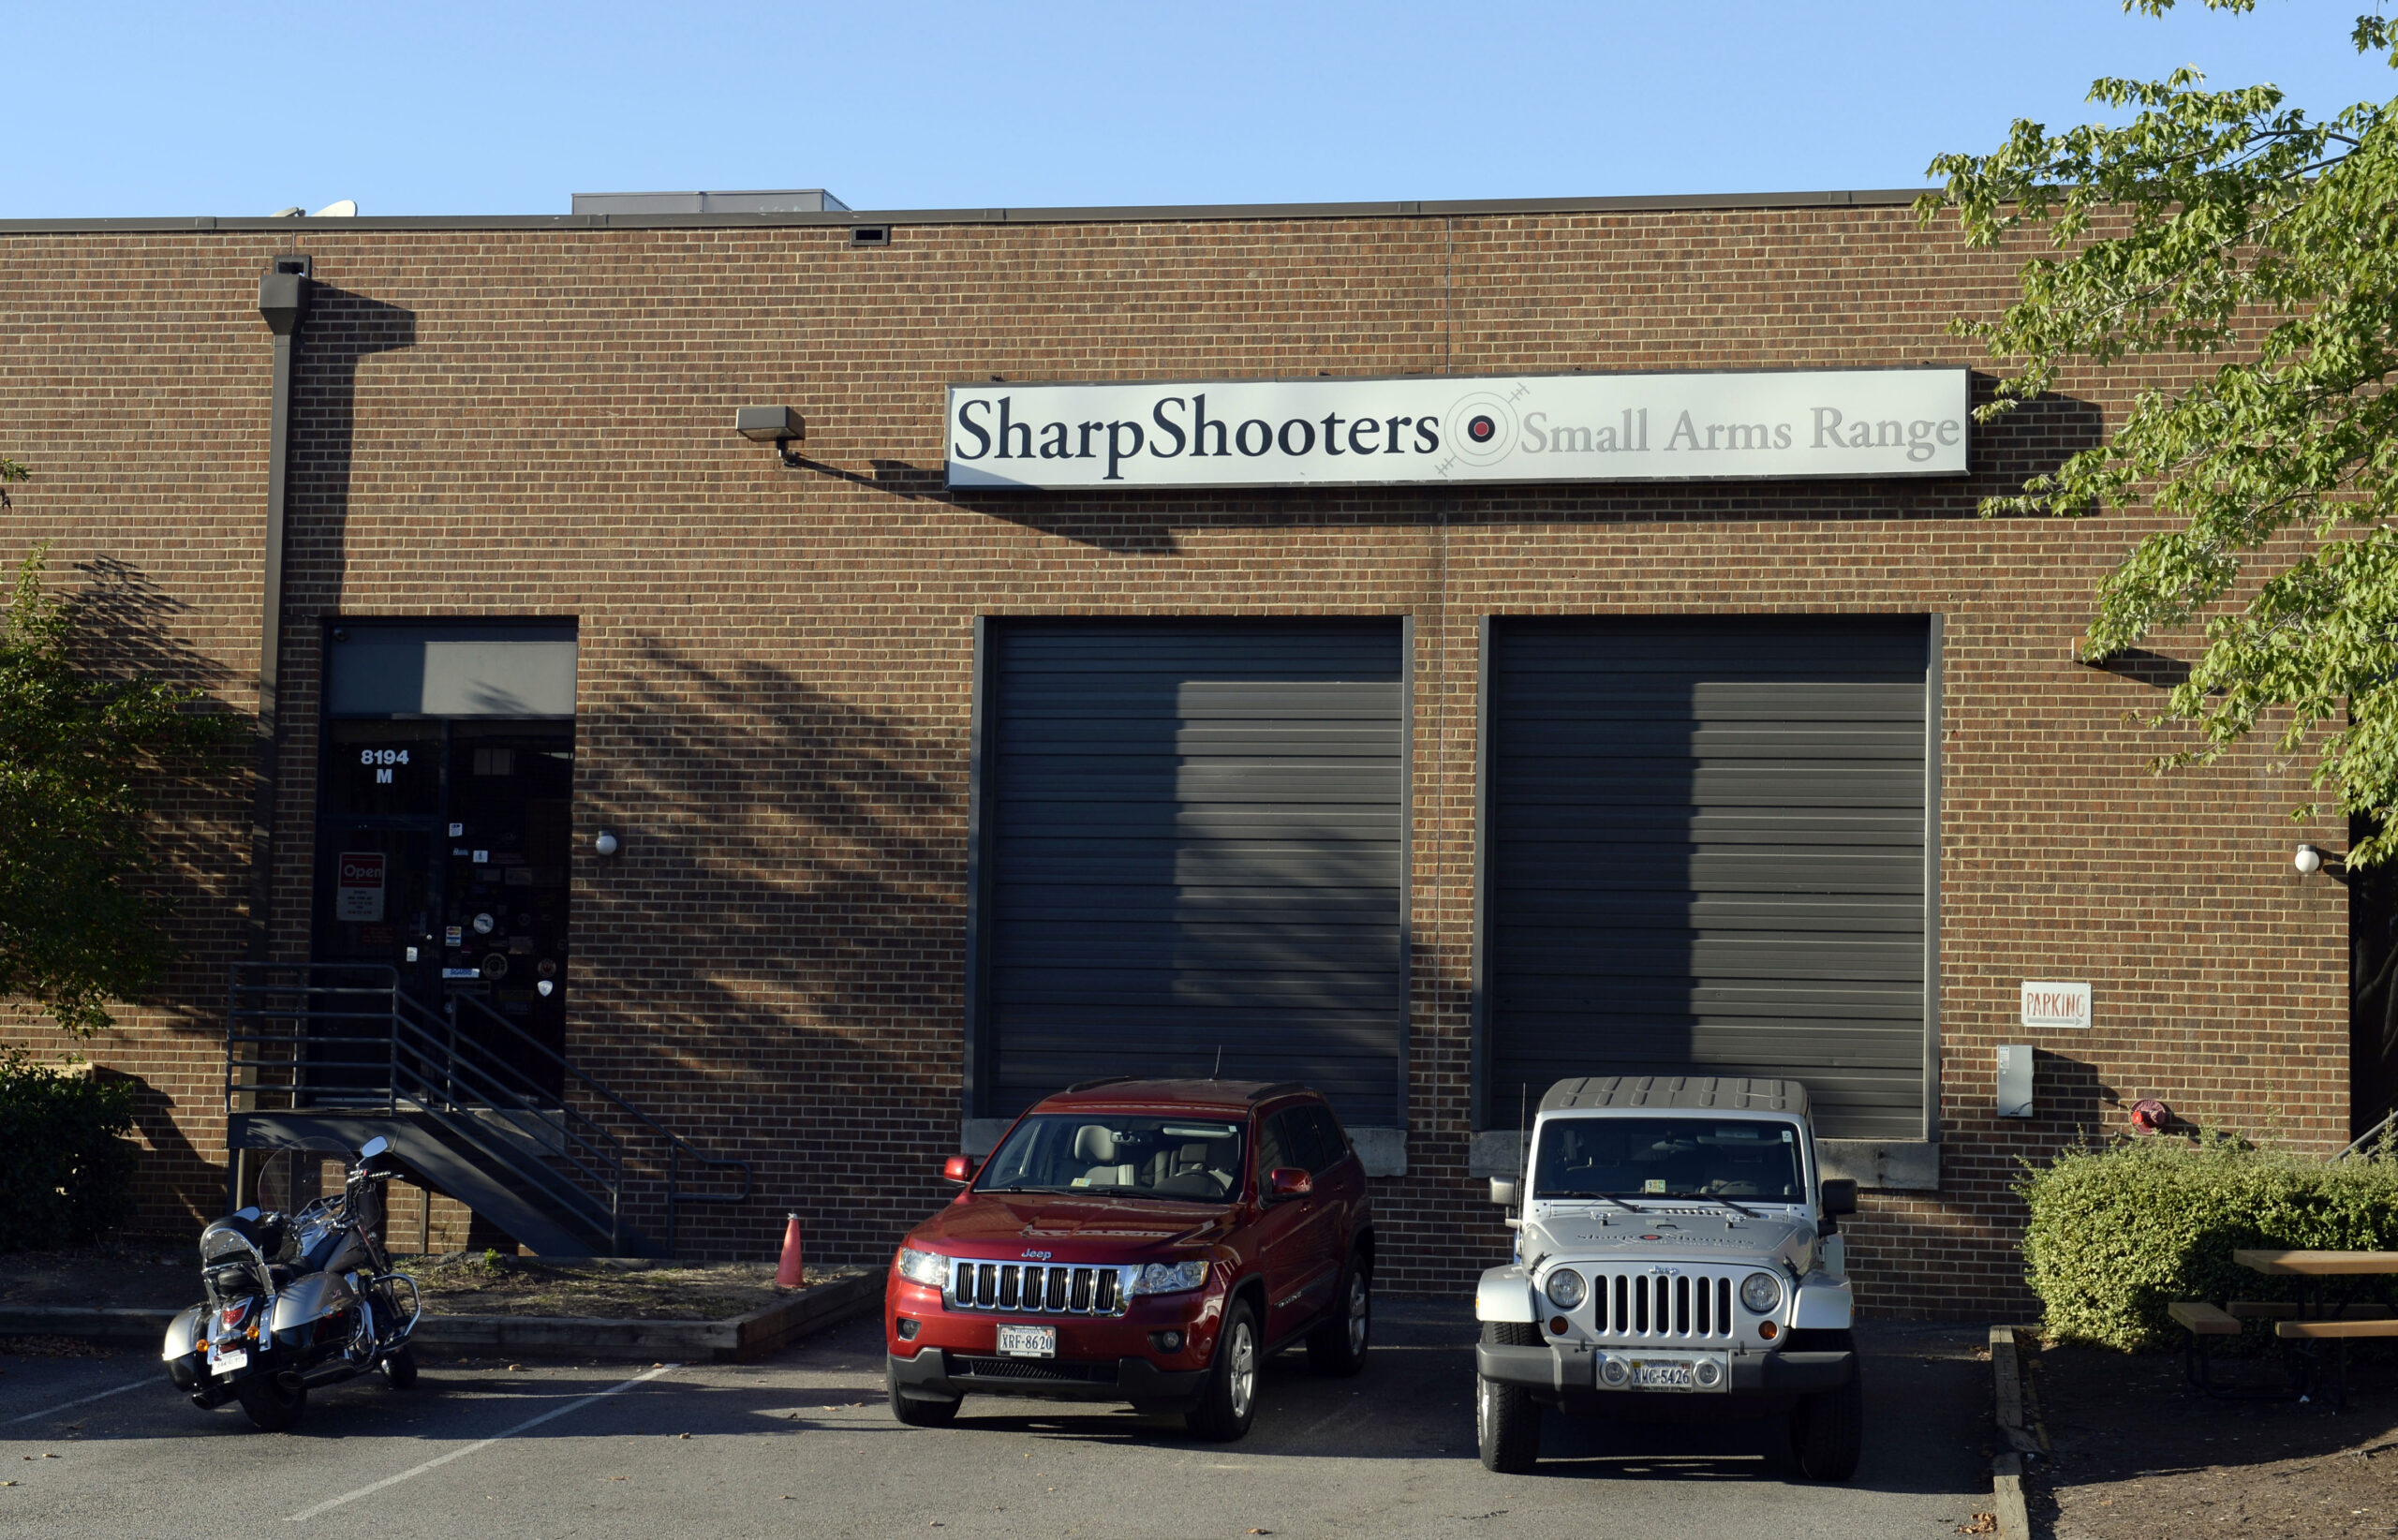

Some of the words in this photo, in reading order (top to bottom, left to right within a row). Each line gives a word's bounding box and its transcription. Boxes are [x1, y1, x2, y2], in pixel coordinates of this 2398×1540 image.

[955, 393, 1440, 480] SharpShooters
[1521, 407, 1650, 454] Small
[1664, 408, 1793, 452] Arms
[1809, 406, 1961, 463] Range
[361, 749, 409, 764] 8194
[377, 768, 392, 783] M
[344, 864, 382, 880] Open
[2026, 992, 2085, 1017] PARKING
[1021, 1248, 1052, 1261] Jeep
[1002, 1334, 1053, 1350] XRF-8620
